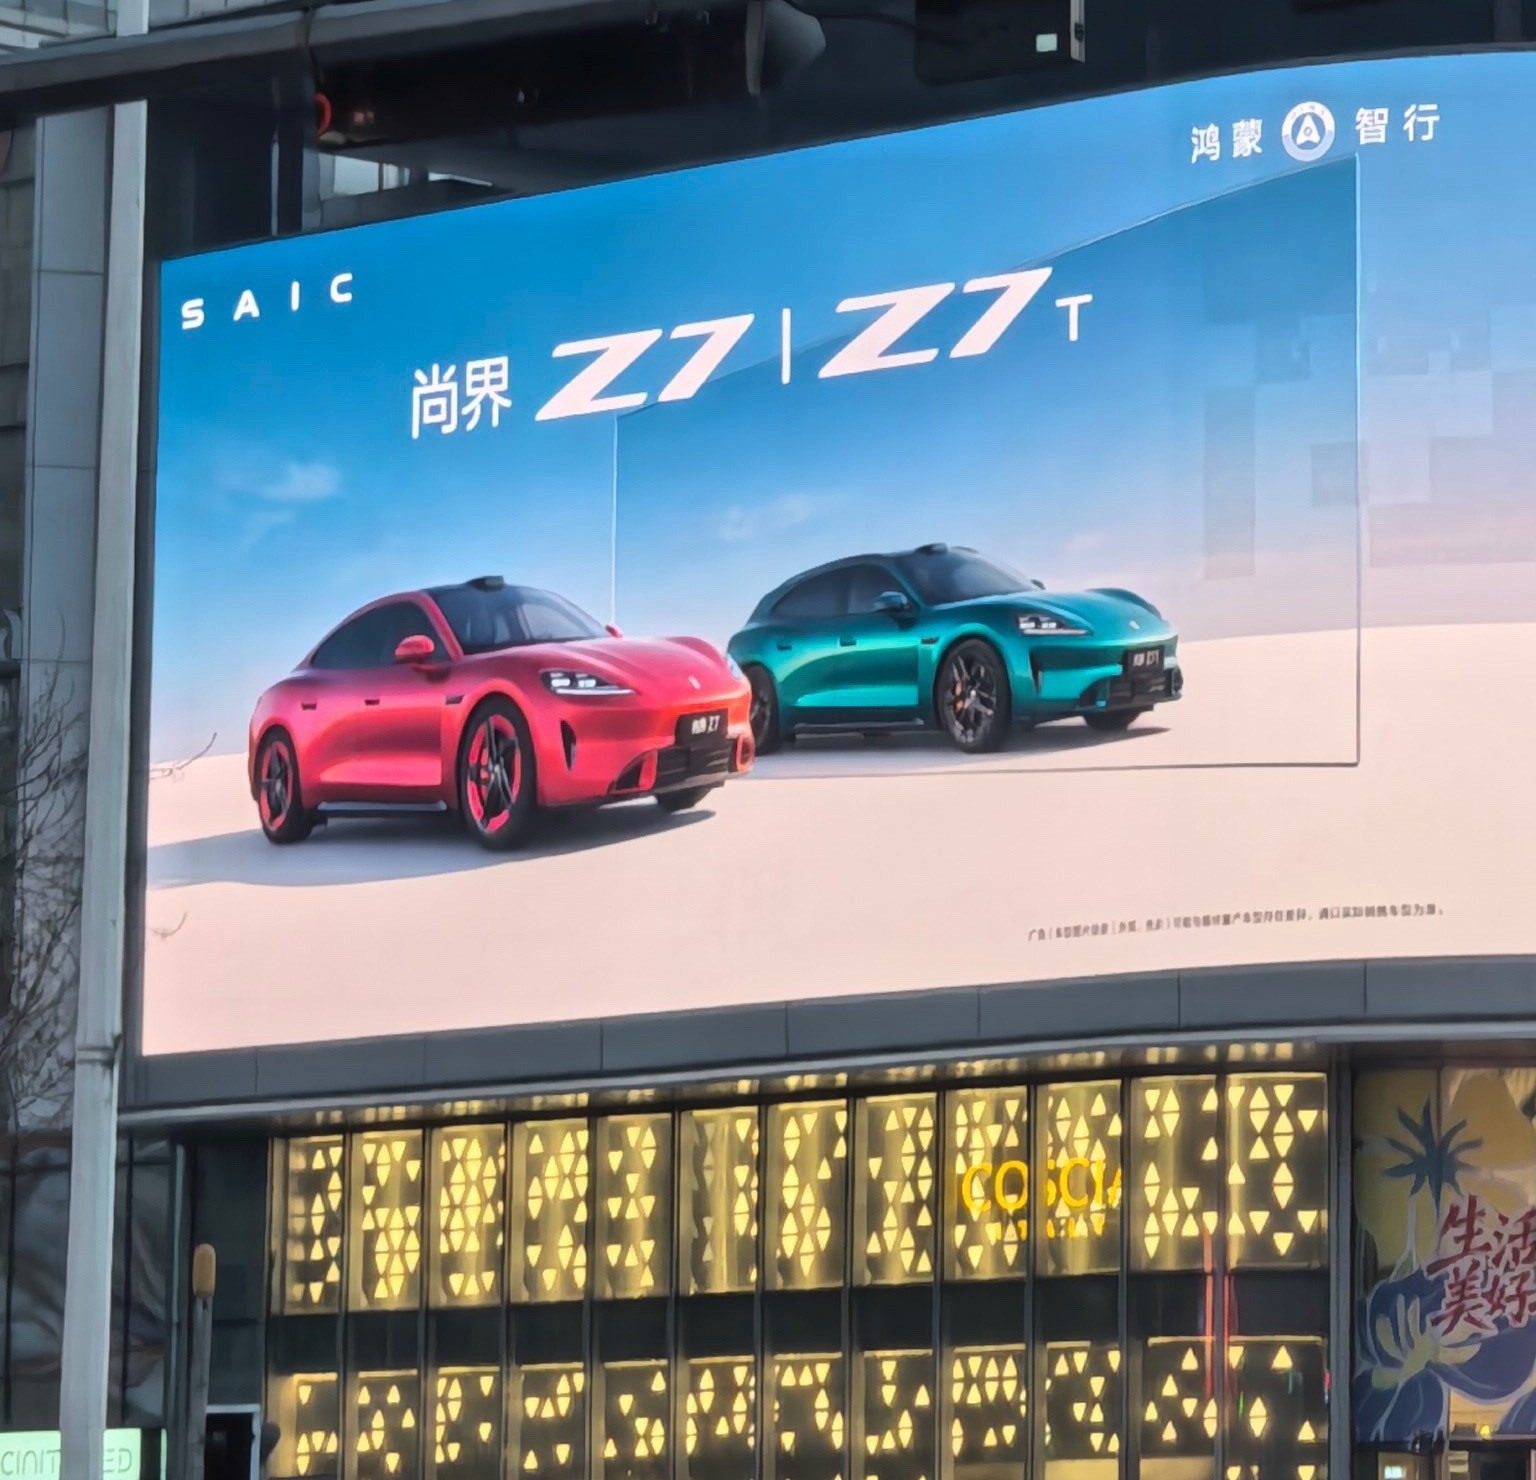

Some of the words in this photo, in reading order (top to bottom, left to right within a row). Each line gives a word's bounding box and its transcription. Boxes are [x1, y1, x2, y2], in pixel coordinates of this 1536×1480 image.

[1191, 117, 1263, 164] 鸿蒙
[1354, 103, 1440, 145] 智行
[181, 273, 353, 330] SAIC
[410, 356, 512, 440] 尚界
[535, 314, 754, 421] Z7
